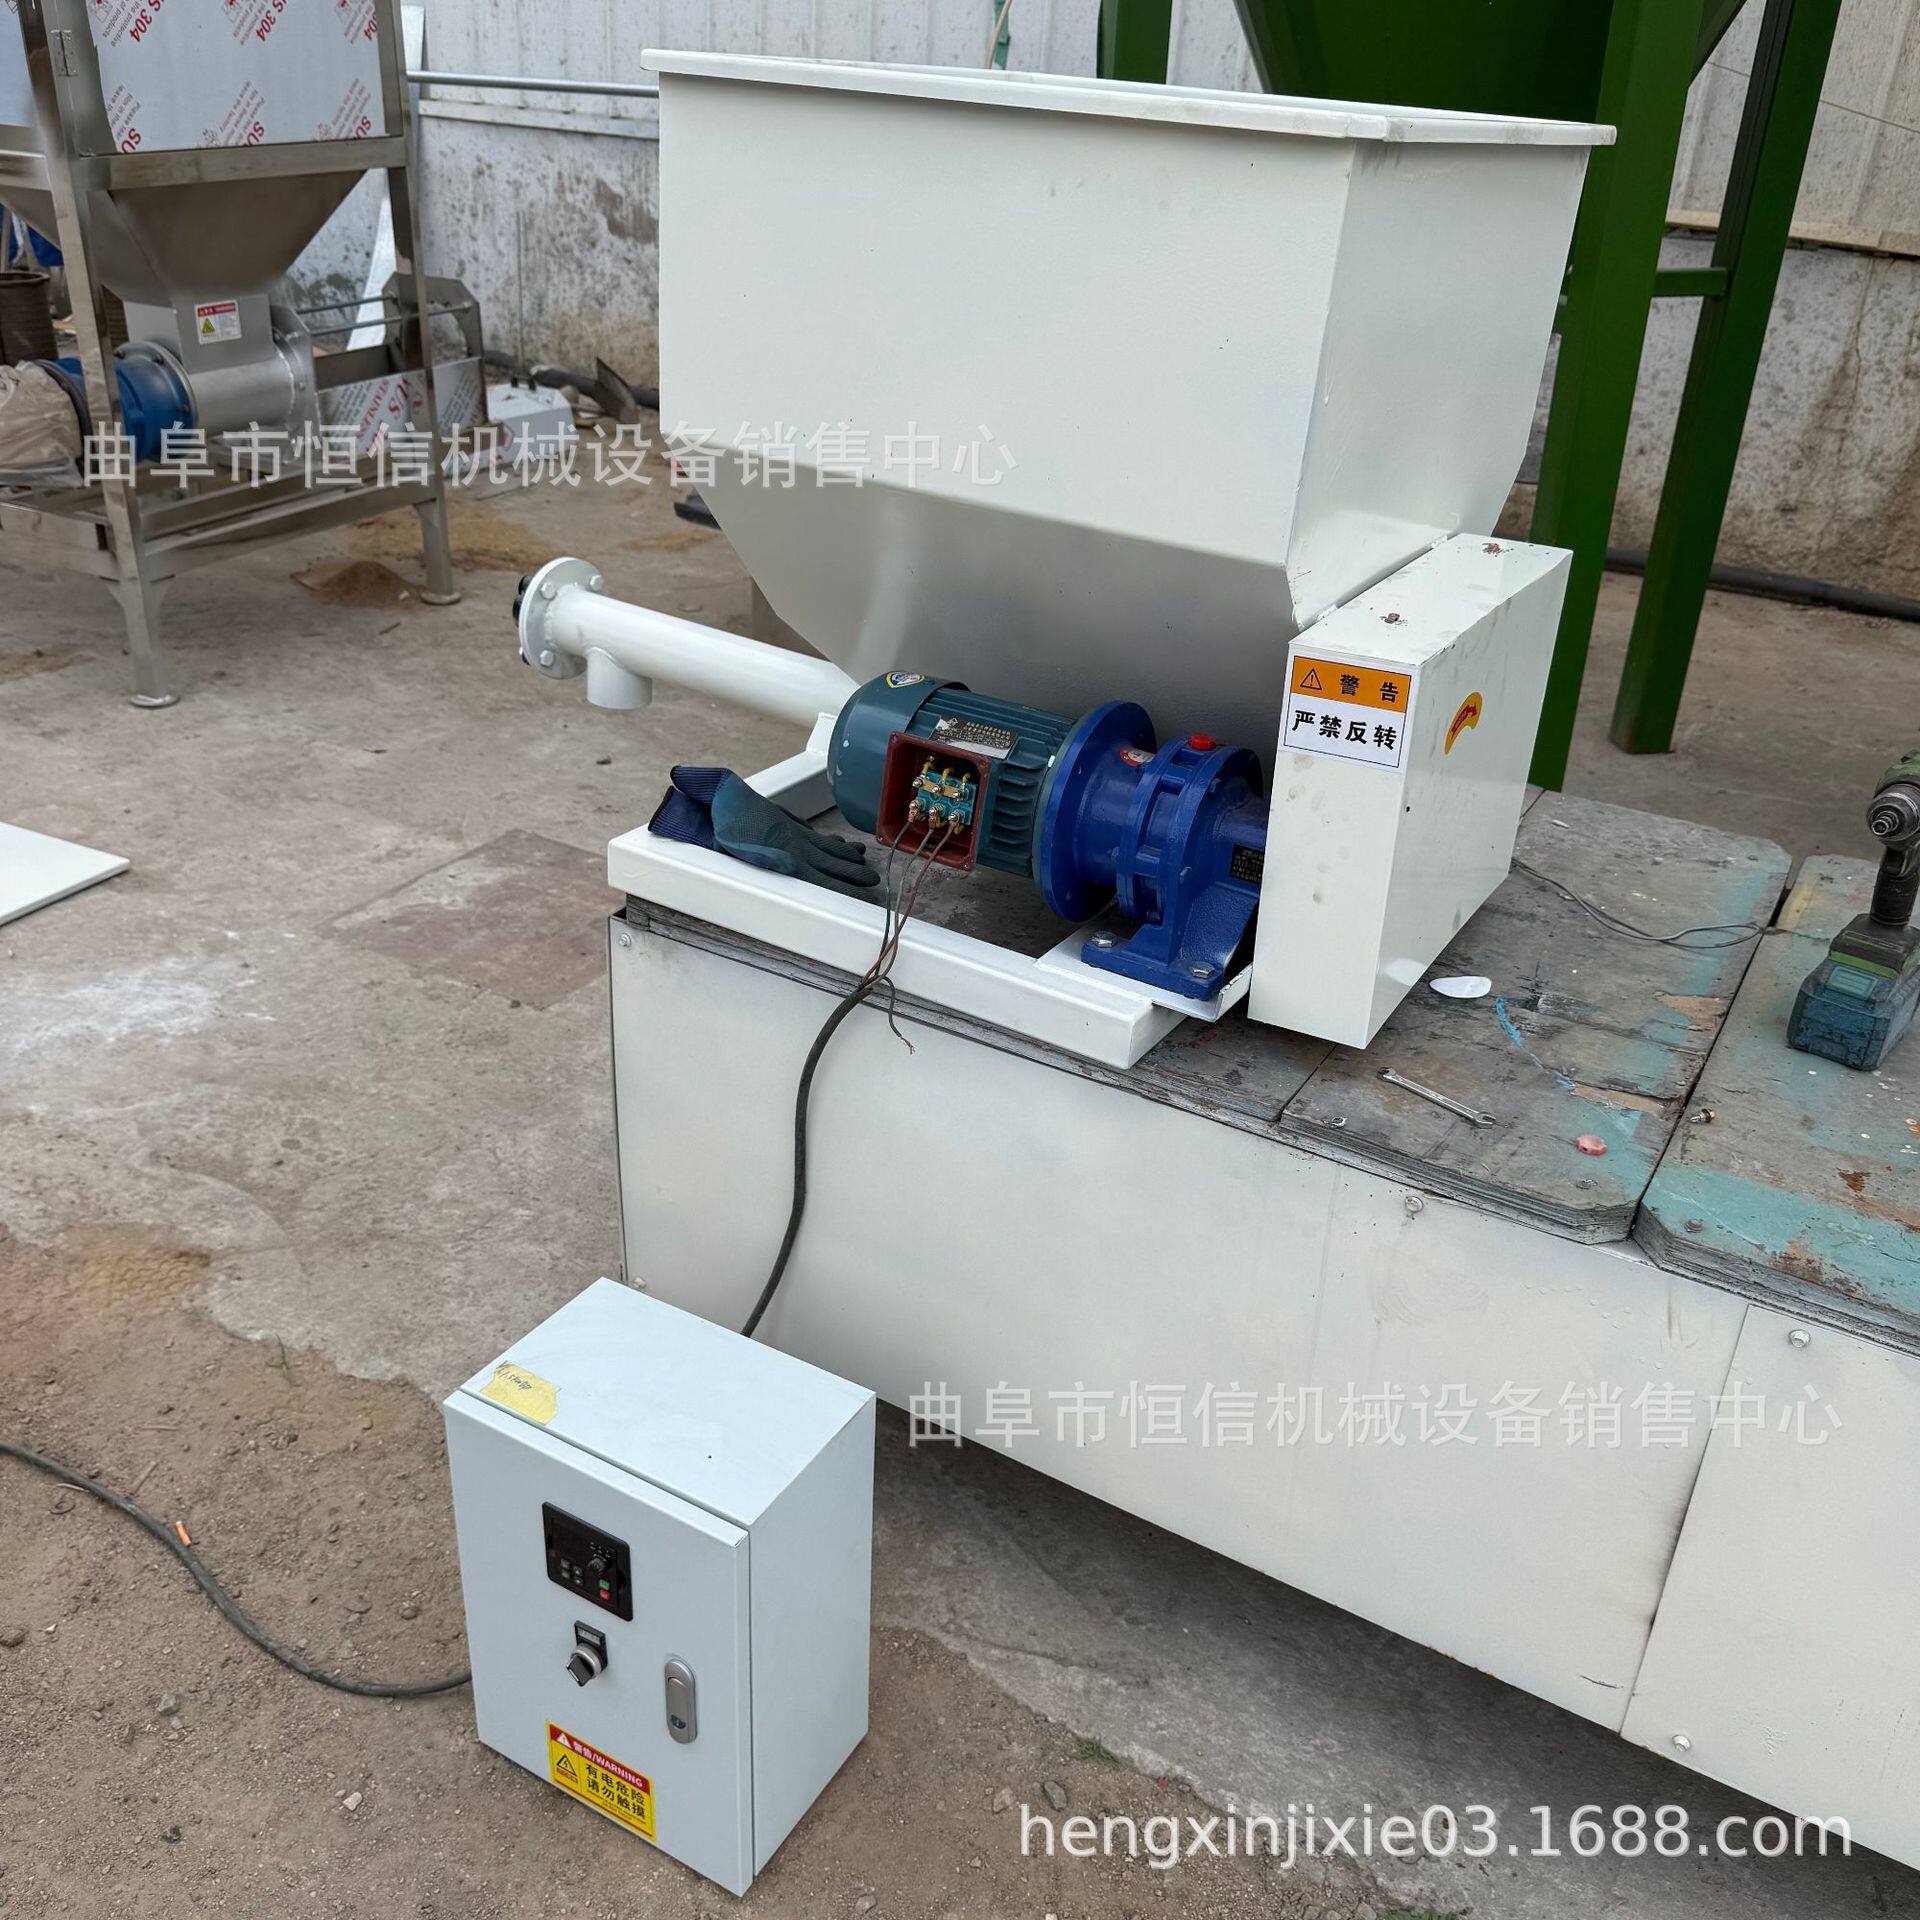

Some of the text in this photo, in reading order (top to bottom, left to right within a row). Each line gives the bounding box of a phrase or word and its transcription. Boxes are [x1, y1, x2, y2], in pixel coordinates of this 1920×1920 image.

[129, 8, 152, 42] 304
[256, 10, 276, 42] 304
[1339, 673, 1400, 704] 警告
[1292, 709, 1398, 750] 严禁反转
[585, 1763, 646, 1806] 有电危险
[586, 1777, 647, 1819] 请勿触摸
